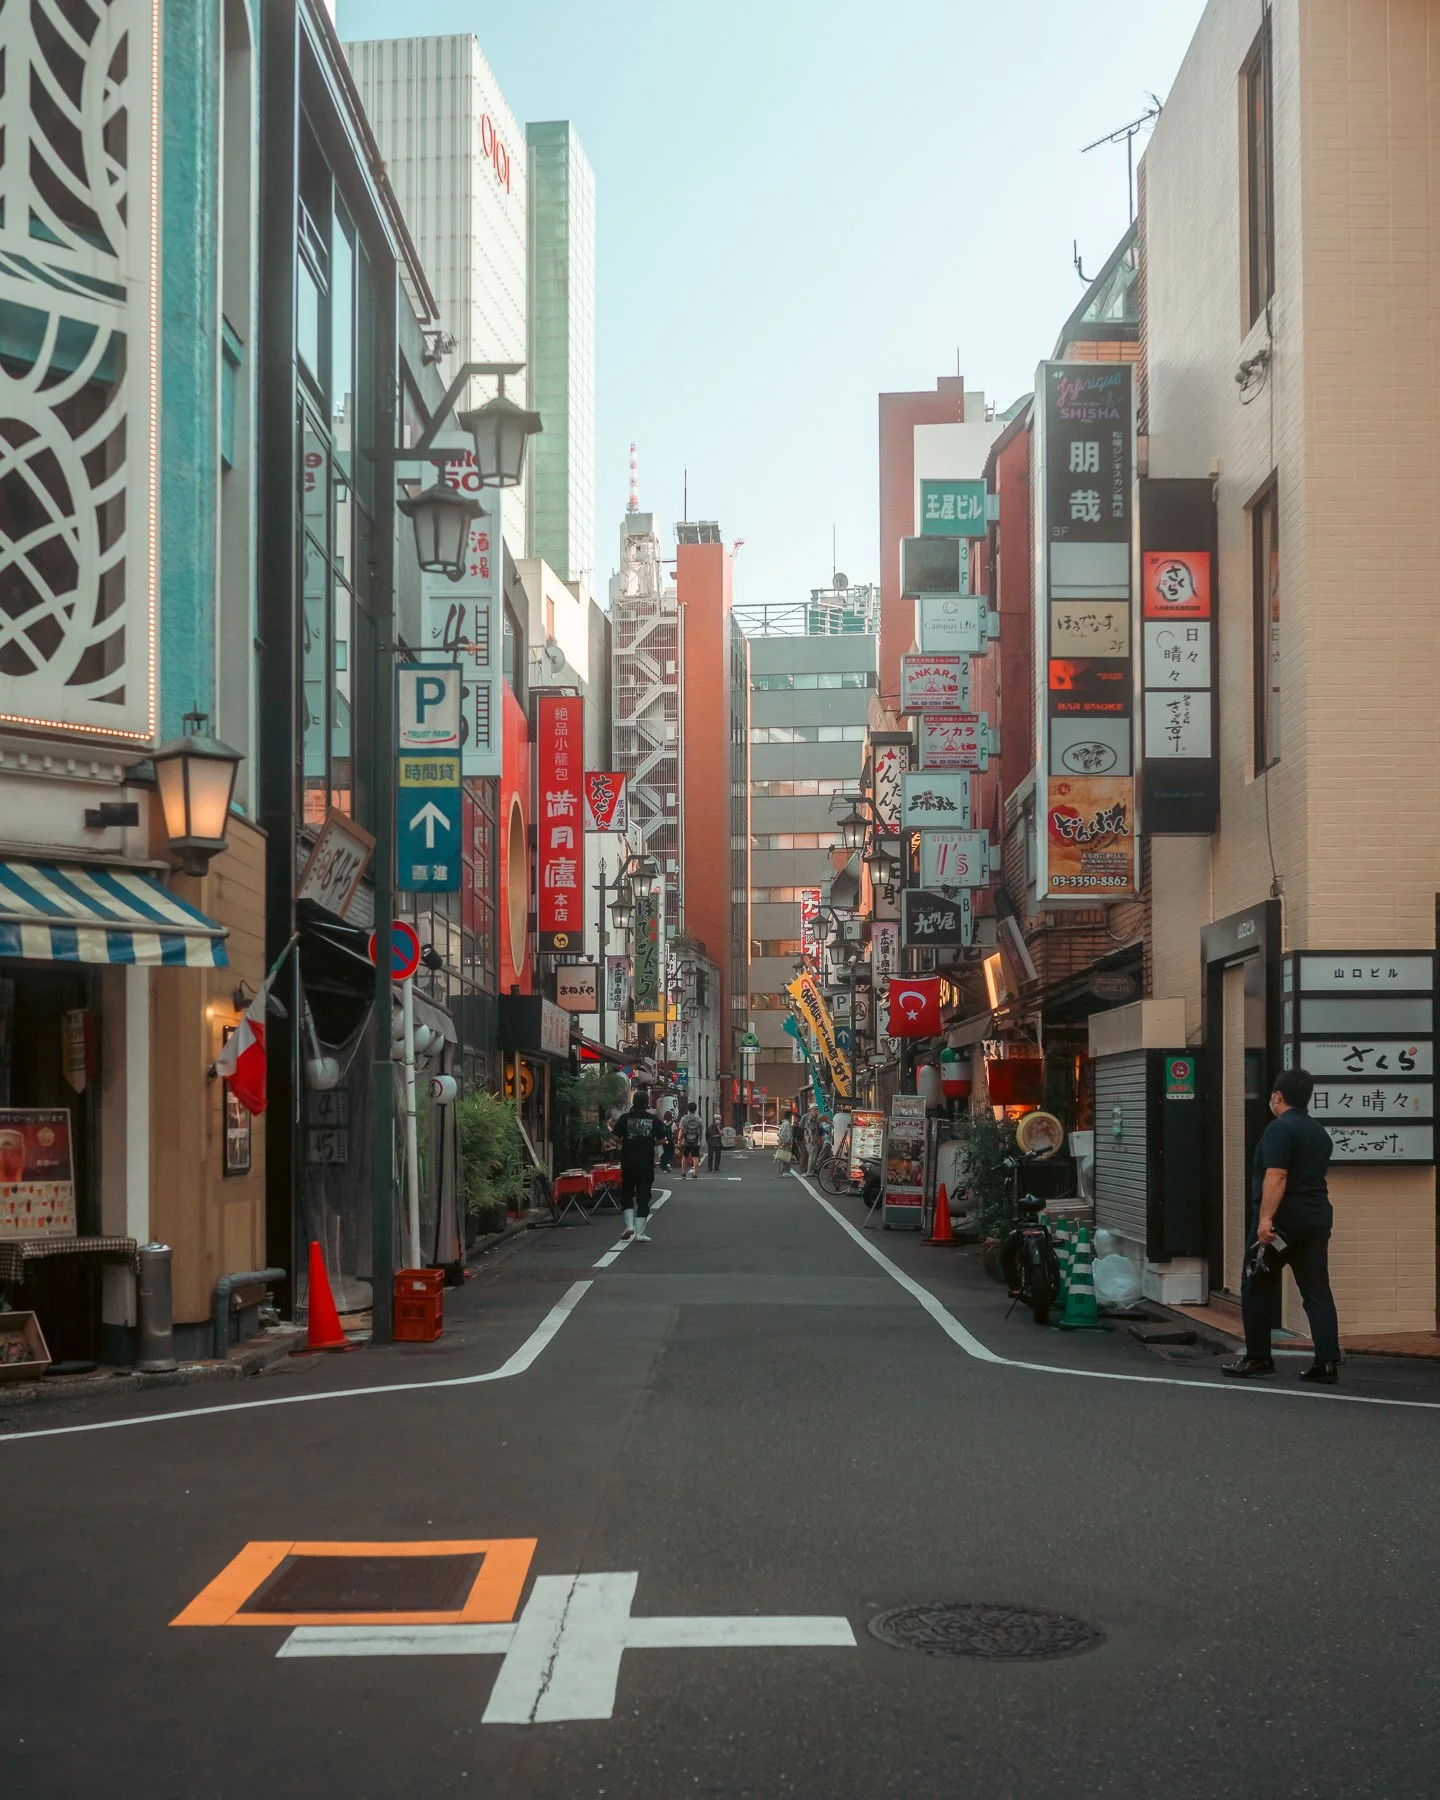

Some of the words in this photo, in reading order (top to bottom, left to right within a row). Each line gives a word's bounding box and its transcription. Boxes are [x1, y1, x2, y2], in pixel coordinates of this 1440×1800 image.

[1060, 408, 1120, 419] SHISHA
[1069, 441, 1101, 522] 朋哉
[1052, 526, 1069, 537] 3F
[908, 668, 958, 683] ANKARA
[415, 677, 446, 724] P
[1057, 703, 1080, 711] BAR
[1084, 703, 1124, 711] SMOKE
[928, 726, 975, 737] アンカラ
[554, 707, 568, 781] 絶品小籠包
[405, 764, 455, 781] 時間貸
[412, 865, 449, 881] 直進
[1052, 875, 1128, 887] 03-3350-8862
[554, 893, 568, 922] 本店
[1334, 967, 1399, 979] 山口ビル
[836, 996, 847, 1010] P
[1342, 1046, 1416, 1072] さくら
[1313, 1089, 1409, 1111] 日々晴々
